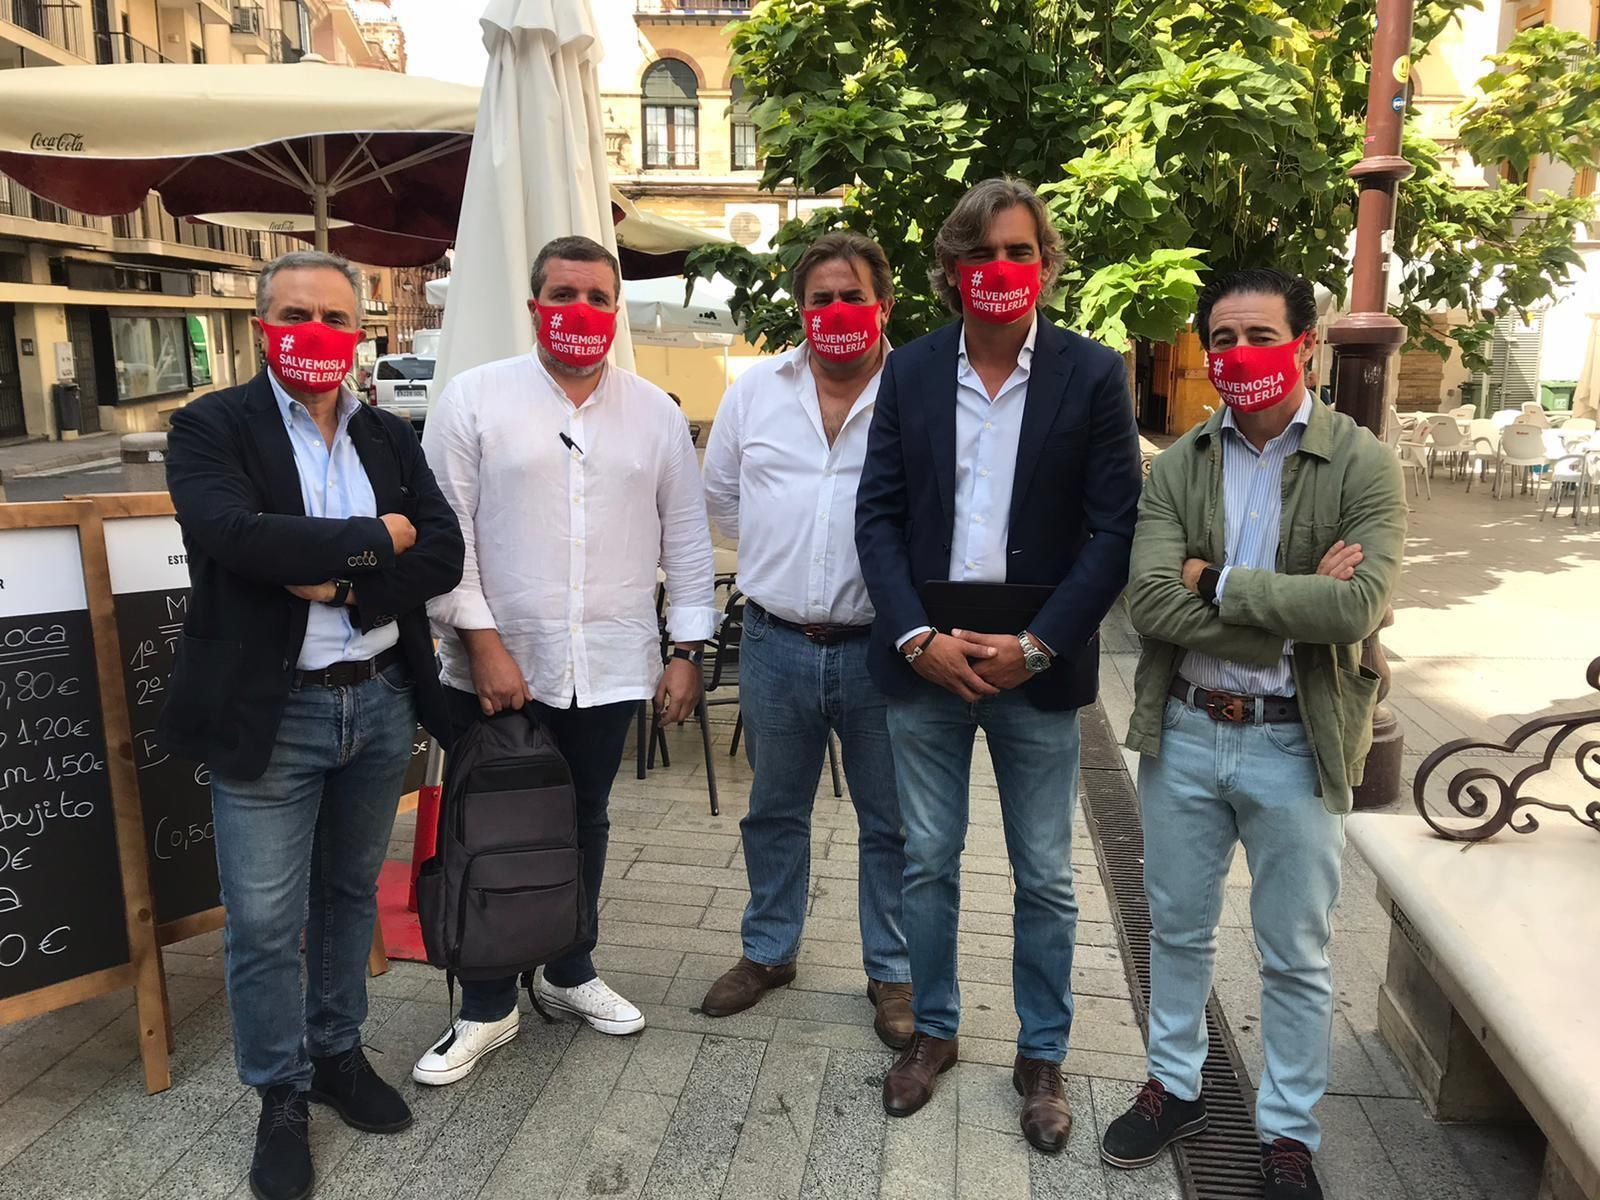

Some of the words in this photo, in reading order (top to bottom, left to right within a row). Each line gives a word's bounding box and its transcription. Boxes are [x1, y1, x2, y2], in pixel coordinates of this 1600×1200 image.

[30, 132, 85, 151] Coca-Cola
[970, 286, 1030, 301] SALVEMOSLA
[549, 330, 607, 344] SALVEMOSLA
[812, 330, 868, 344] SALVEMOSLA
[279, 353, 346, 370] SALVEMOSLA
[1220, 385, 1283, 406] OSTELERÍA
